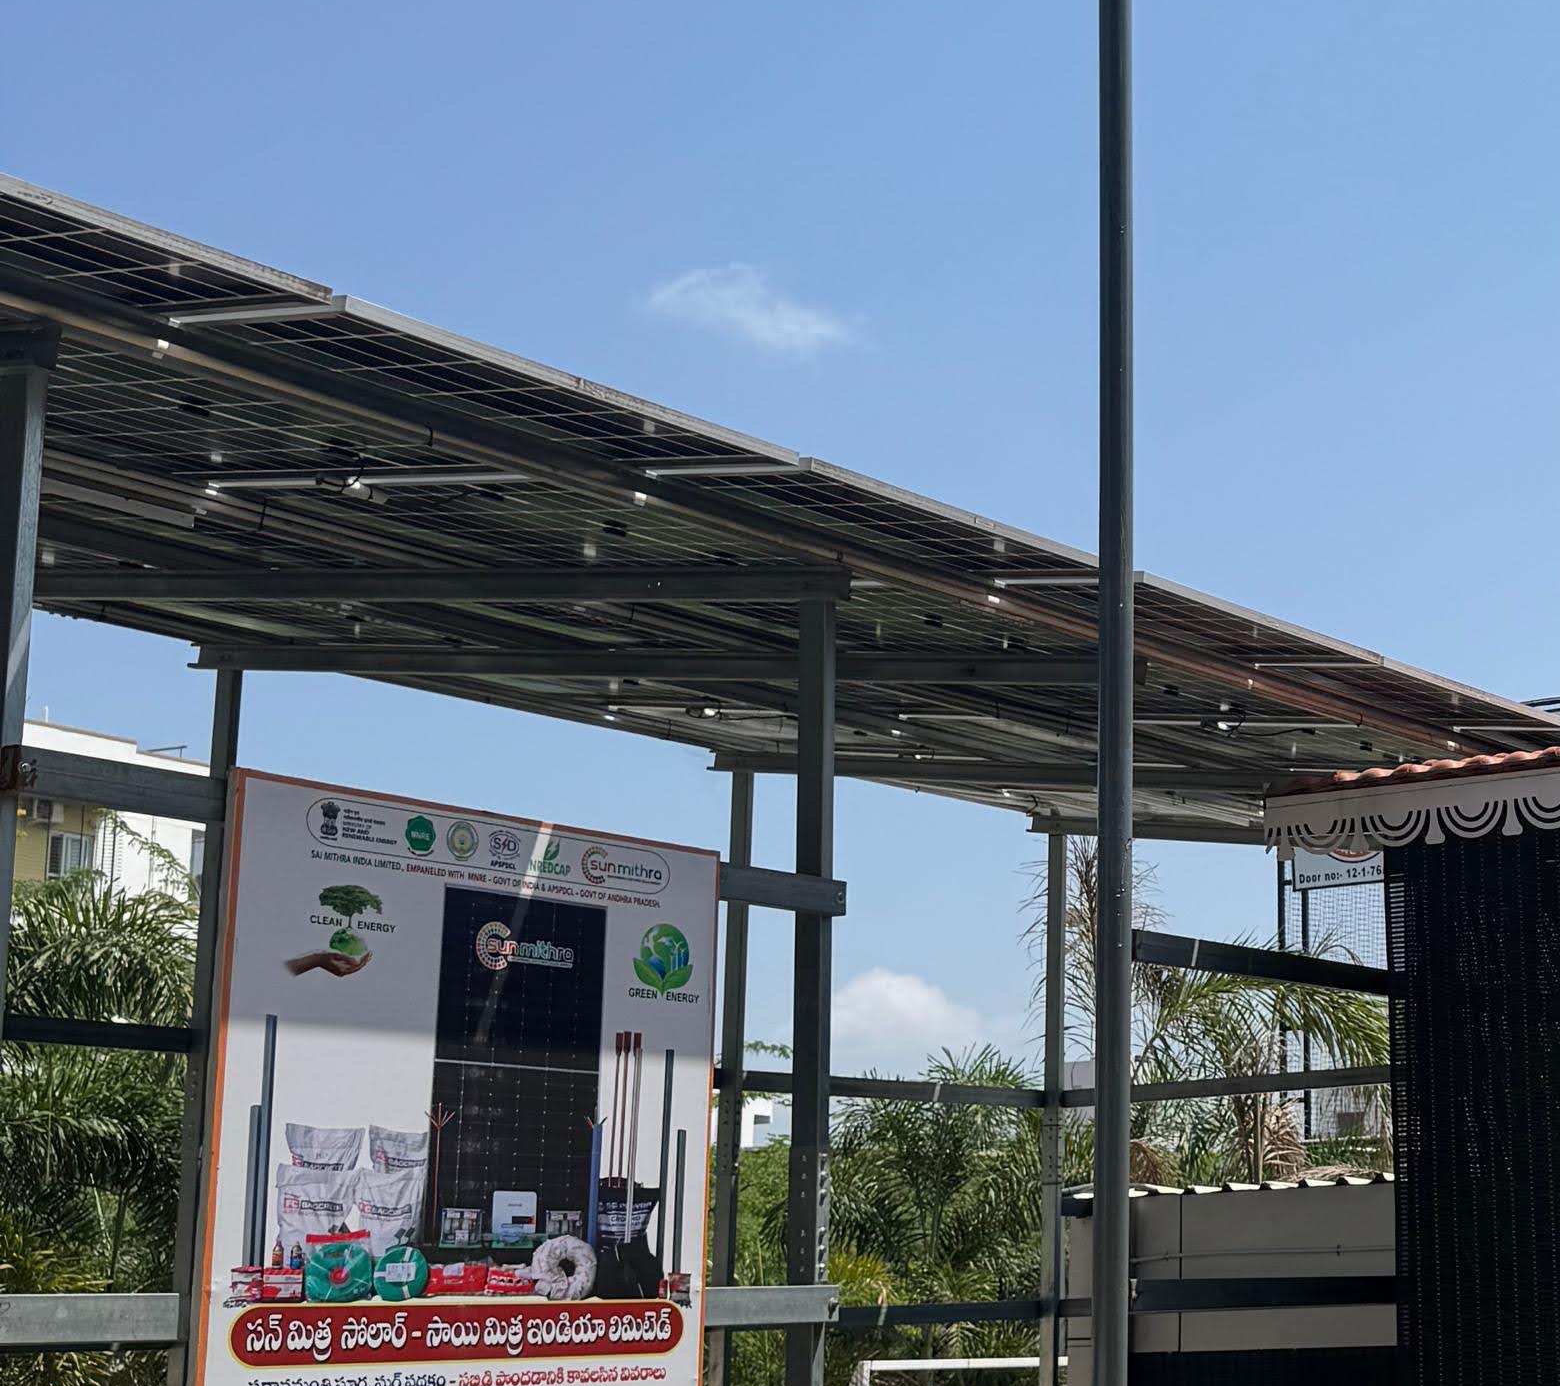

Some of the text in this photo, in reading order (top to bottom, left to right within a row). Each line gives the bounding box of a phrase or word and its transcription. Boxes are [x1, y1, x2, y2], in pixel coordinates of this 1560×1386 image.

[309, 914, 396, 933] CLEAN ENERGY
[627, 986, 699, 1003] GREEN ENERGY
[245, 1307, 671, 1361] సన్ మిత్ర సోలార్ సాయి మిత్ర ఇండియా లిమిటెడ్
[495, 1366, 564, 1386] పొందడానికి
[566, 1365, 618, 1384] కావలసిన
[619, 1365, 666, 1381] వివరాలు
